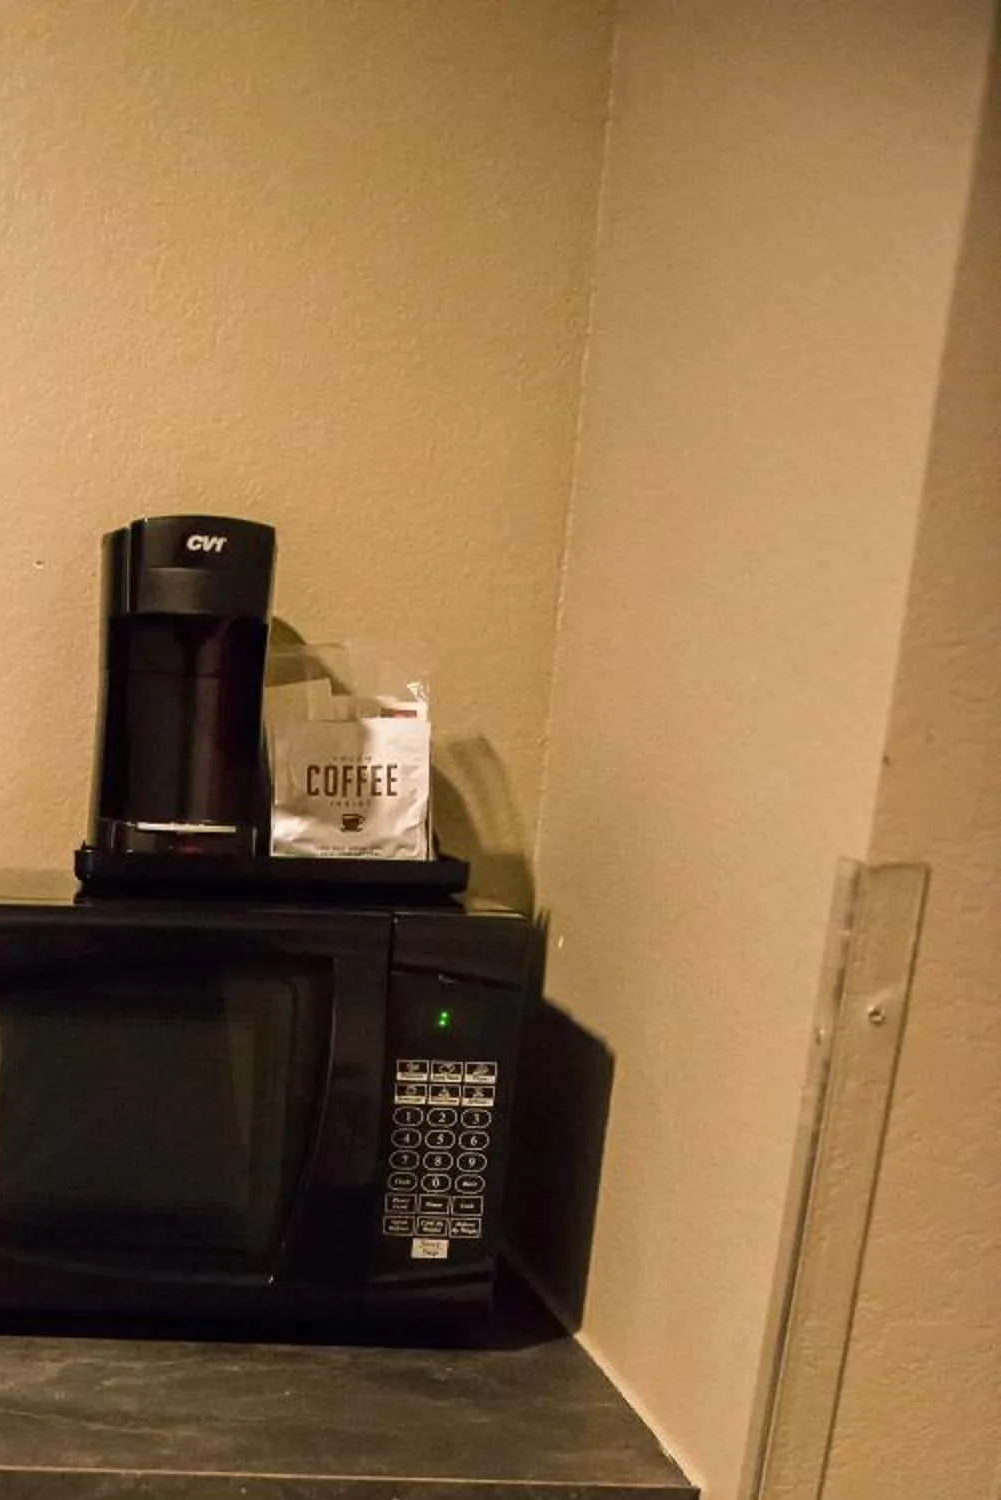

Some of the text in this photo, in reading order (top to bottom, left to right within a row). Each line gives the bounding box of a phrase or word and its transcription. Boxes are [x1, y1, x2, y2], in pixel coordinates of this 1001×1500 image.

[306, 763, 398, 797] COFFEE
[438, 1111, 446, 1123] 2
[472, 1113, 480, 1125] 3
[436, 1133, 445, 1145] 5
[470, 1135, 478, 1147] 6
[434, 1156, 442, 1168] 8
[468, 1157, 476, 1169] 9
[432, 1177, 440, 1188] 0
